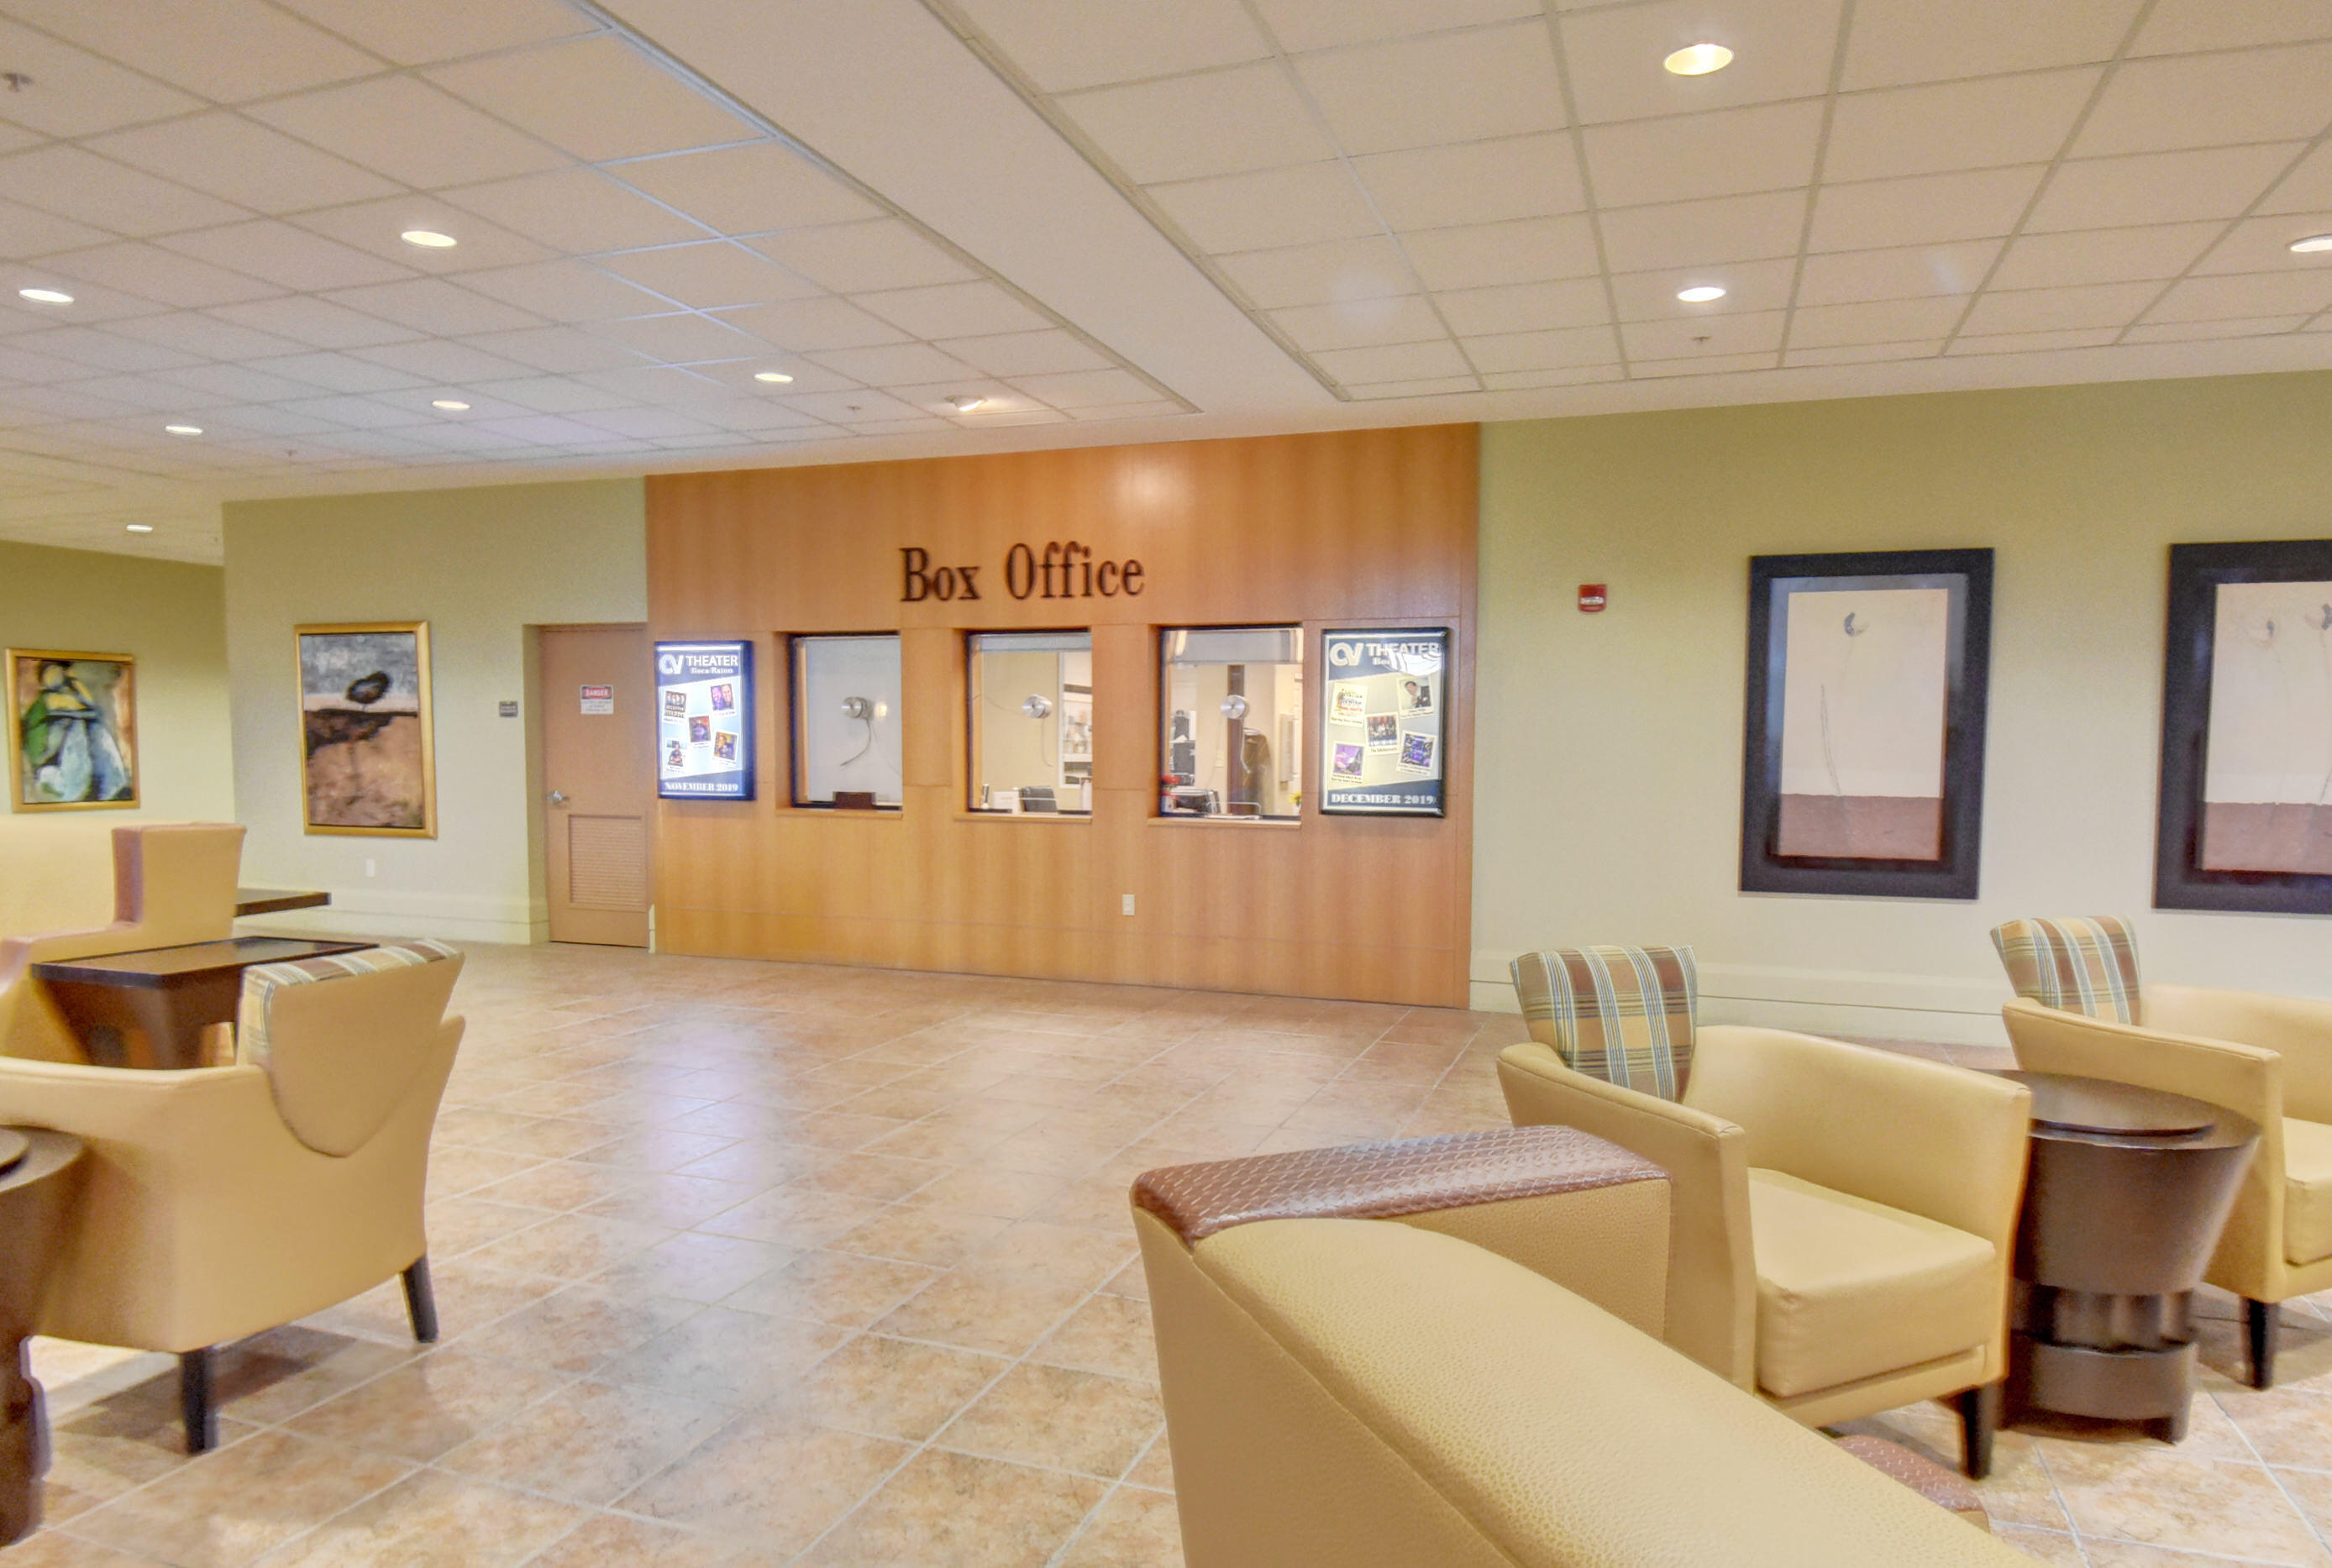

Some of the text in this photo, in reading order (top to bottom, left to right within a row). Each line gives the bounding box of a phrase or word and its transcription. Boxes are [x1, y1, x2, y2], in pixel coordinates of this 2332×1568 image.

[899, 540, 1145, 602] Box Office
[1365, 642, 1440, 657] THEATER
[685, 654, 739, 667] THEATER
[664, 781, 739, 792] NOVEMBER 2019
[1331, 793, 1434, 805] DECEMBER 2019
